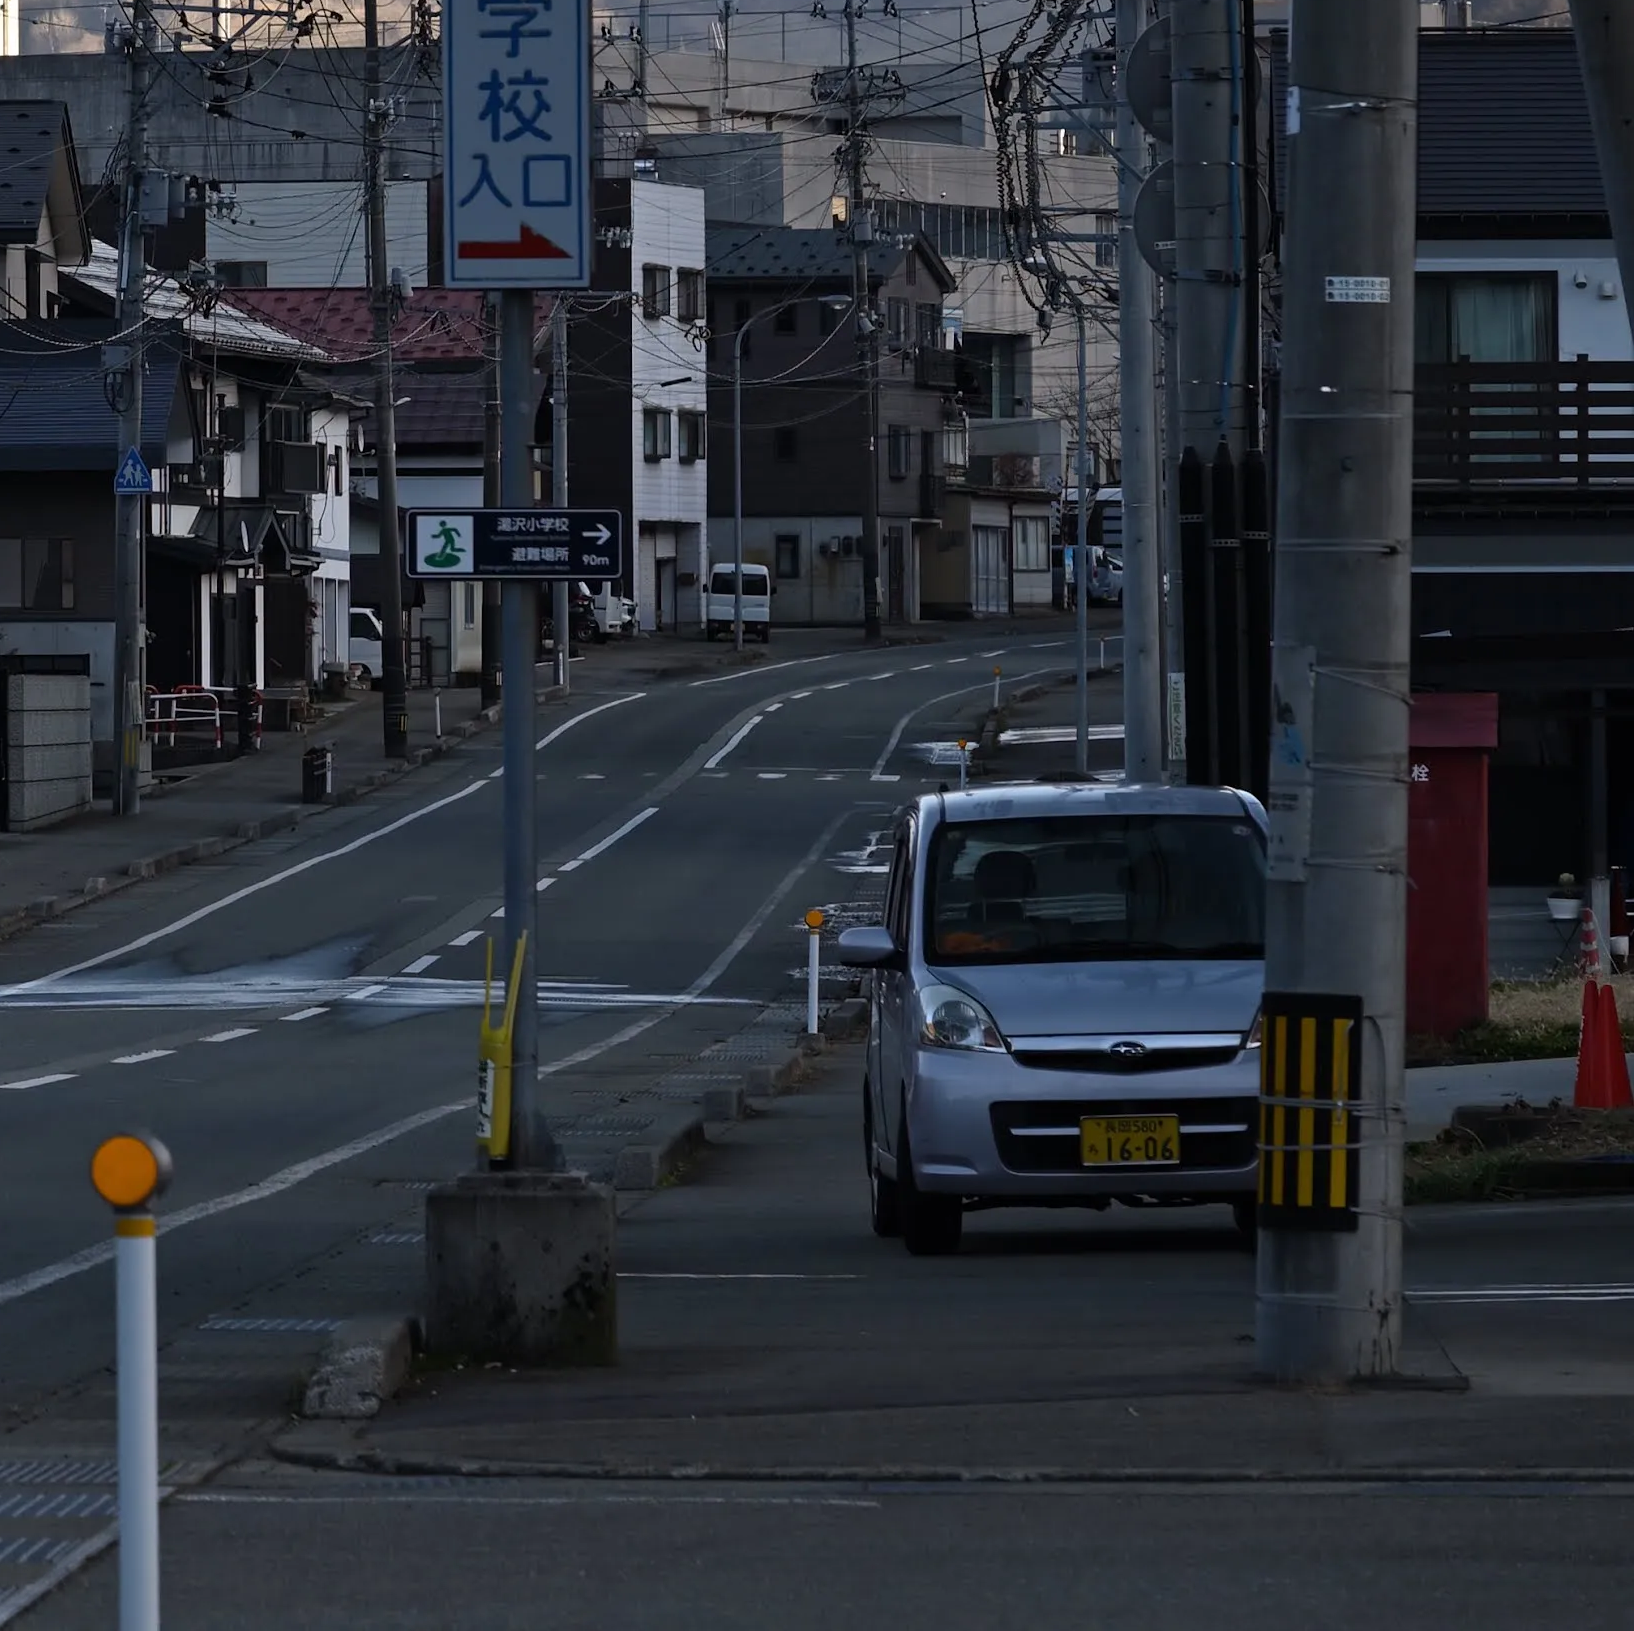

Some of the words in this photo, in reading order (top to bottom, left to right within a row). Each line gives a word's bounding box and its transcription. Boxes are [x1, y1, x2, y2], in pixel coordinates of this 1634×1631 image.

[458, 153, 573, 208] 入口
[496, 516, 570, 532] 湯沢小学校
[511, 546, 570, 562] 避難場所
[581, 553, 610, 566] 90m
[1107, 1135, 1175, 1162] 16-06
